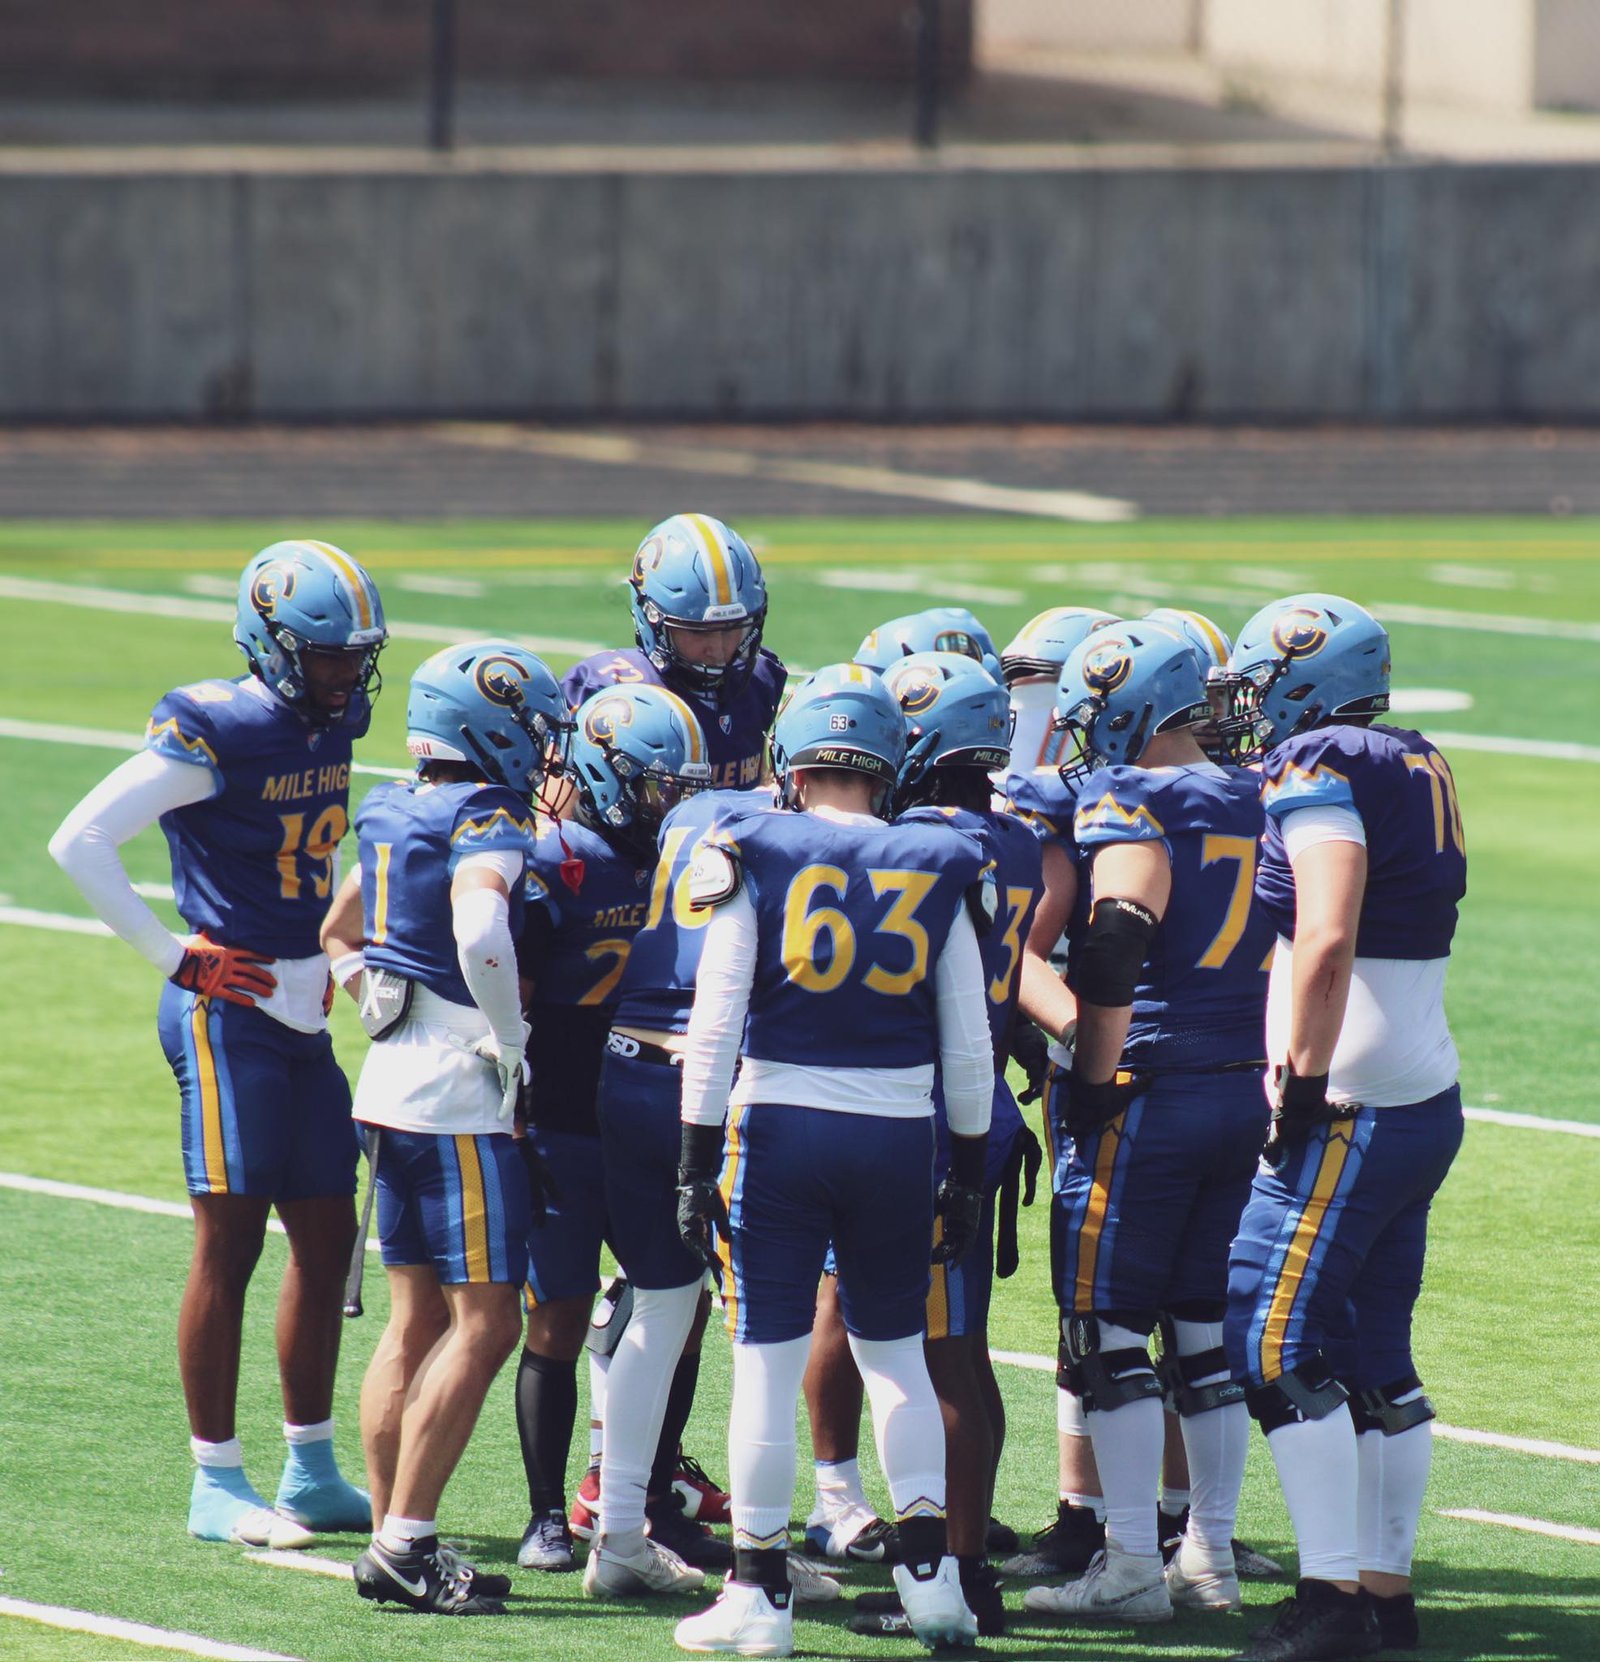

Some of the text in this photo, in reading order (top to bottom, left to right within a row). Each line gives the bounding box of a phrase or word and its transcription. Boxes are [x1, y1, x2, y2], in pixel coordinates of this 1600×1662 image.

[829, 713, 848, 731] 63
[261, 769, 316, 801] MILE
[815, 750, 882, 771] MILE HIGH
[973, 750, 1000, 763] MILE
[275, 804, 346, 898] 19
[372, 841, 394, 945] 1
[1194, 832, 1277, 972] 7
[781, 863, 943, 996] 63
